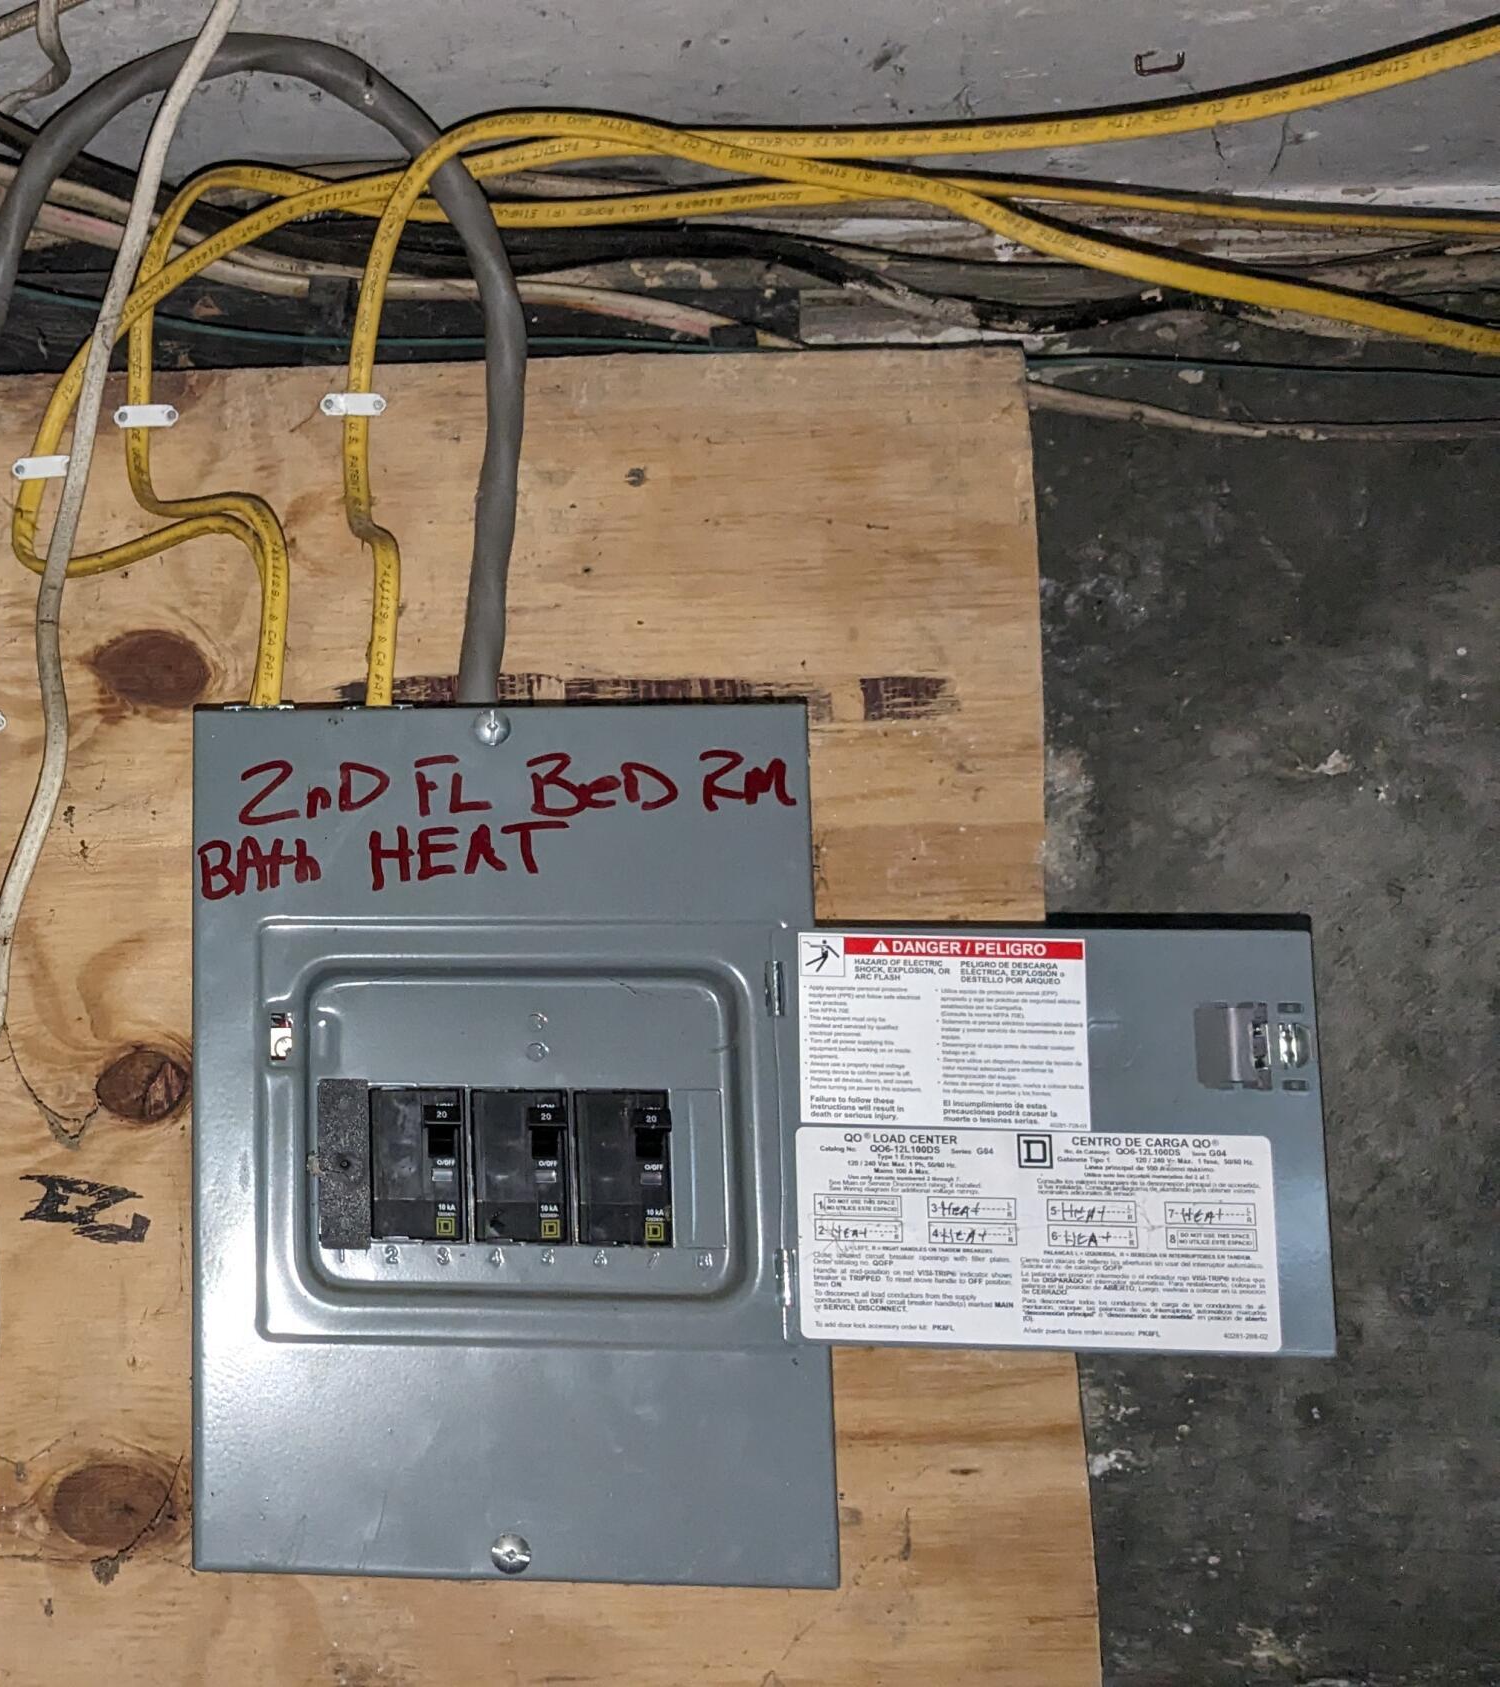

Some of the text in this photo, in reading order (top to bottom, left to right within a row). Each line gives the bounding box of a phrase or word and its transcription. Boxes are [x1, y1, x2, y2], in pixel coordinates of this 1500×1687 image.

[414, 754, 492, 816] FL
[369, 821, 569, 891] HEAT
[892, 940, 961, 955] DANGER
[975, 942, 1047, 956] PELIGRO
[854, 958, 888, 966] HAZARD
[903, 959, 943, 967] ELECTRIC
[960, 960, 1058, 970] PELIGRO DE DESCARGA
[854, 966, 886, 974] SHOCK,
[887, 967, 937, 975] EXPLOSION,
[960, 976, 1004, 984] DESTELLO
[1025, 977, 1061, 985] ARQUEO
[810, 1095, 836, 1103] Failure
[848, 1096, 871, 1104] follow
[810, 1103, 856, 1111] instructions
[952, 1100, 1013, 1109] incumplimiento
[437, 1111, 448, 1119] 20
[541, 1113, 552, 1121] 20
[874, 1112, 899, 1121] injury.
[943, 1108, 995, 1116] precauciones
[1022, 1110, 1048, 1118] causar
[646, 1115, 657, 1123] 20
[979, 1116, 1013, 1124] lesiones
[873, 1133, 906, 1144] LOAD
[909, 1134, 958, 1145] CENTER
[1071, 1136, 1121, 1147] CENTRO
[1125, 1137, 1142, 1147] DE
[1146, 1137, 1189, 1148] CARGA
